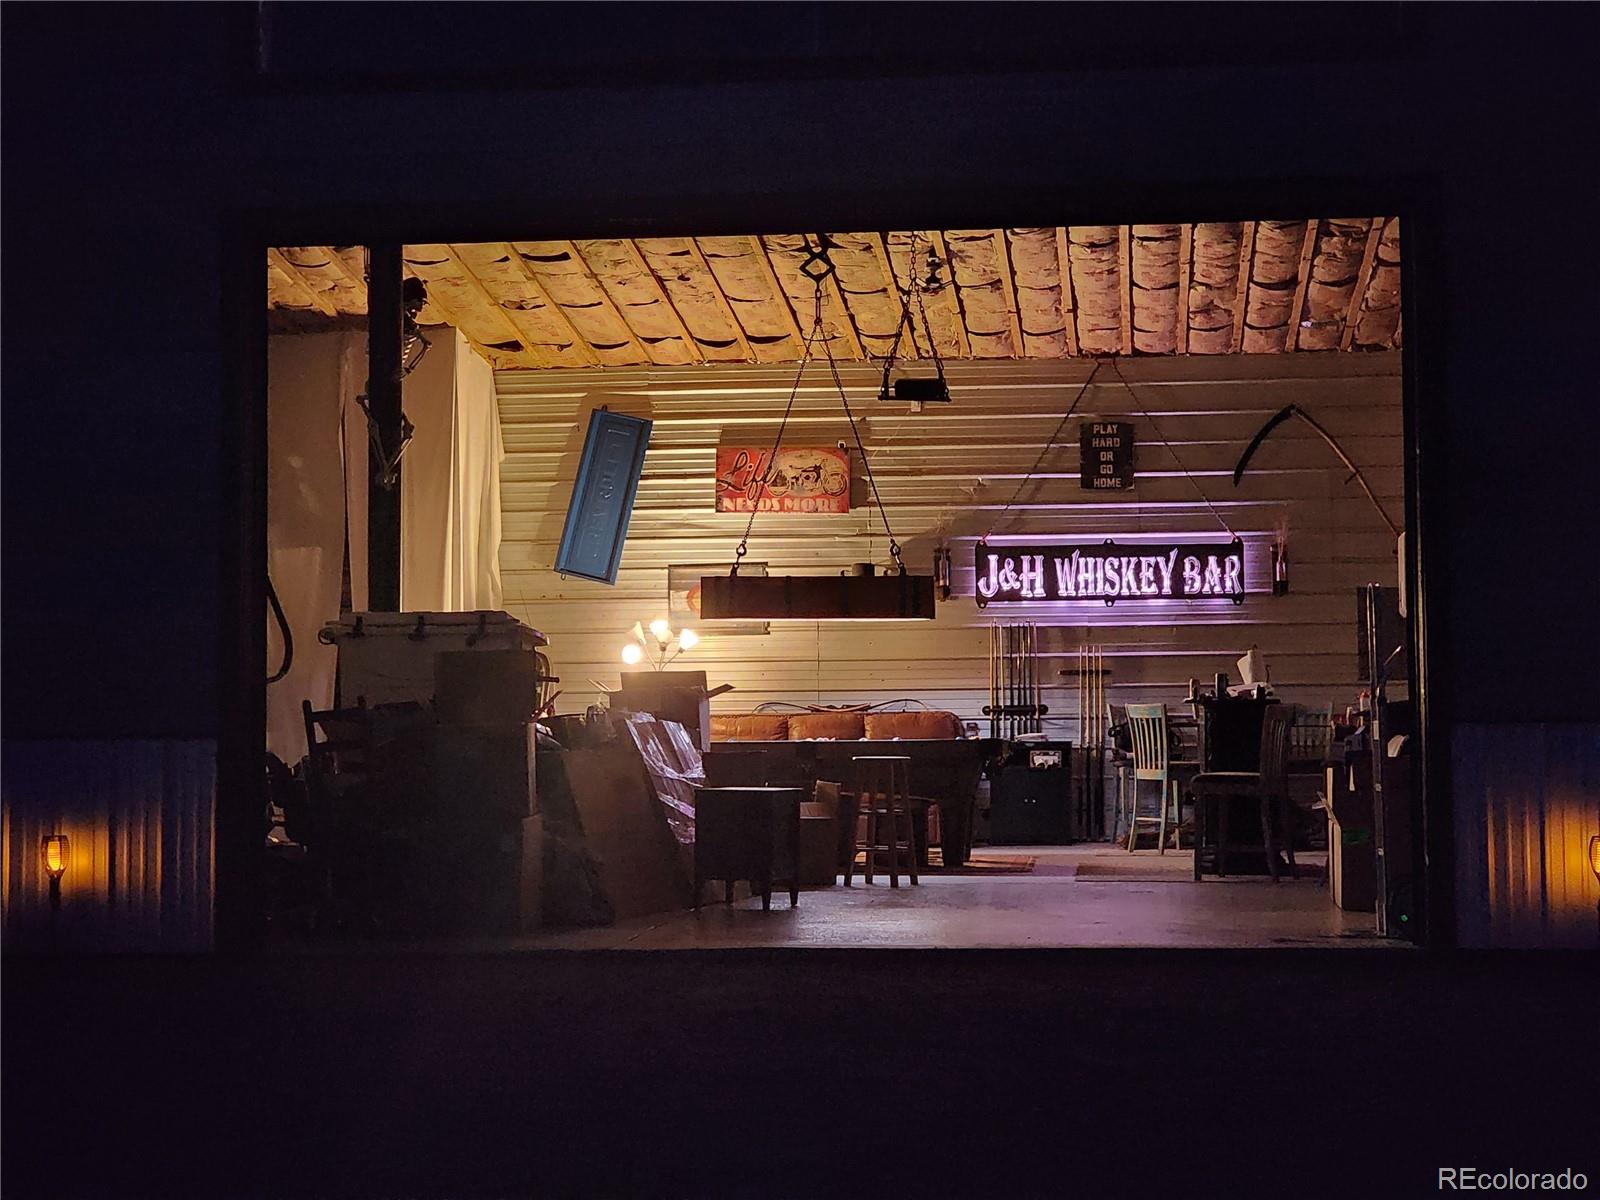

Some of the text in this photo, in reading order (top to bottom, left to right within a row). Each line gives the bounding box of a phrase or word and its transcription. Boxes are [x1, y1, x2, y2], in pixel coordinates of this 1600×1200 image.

[1093, 424, 1118, 434] PLAY
[1092, 438, 1120, 448] HARD
[1100, 451, 1114, 461] OR
[1100, 464, 1113, 474] GO
[1093, 478, 1122, 488] HOME
[783, 497, 840, 512] MORE
[977, 548, 1243, 598] J&H WHISKEY BAR
